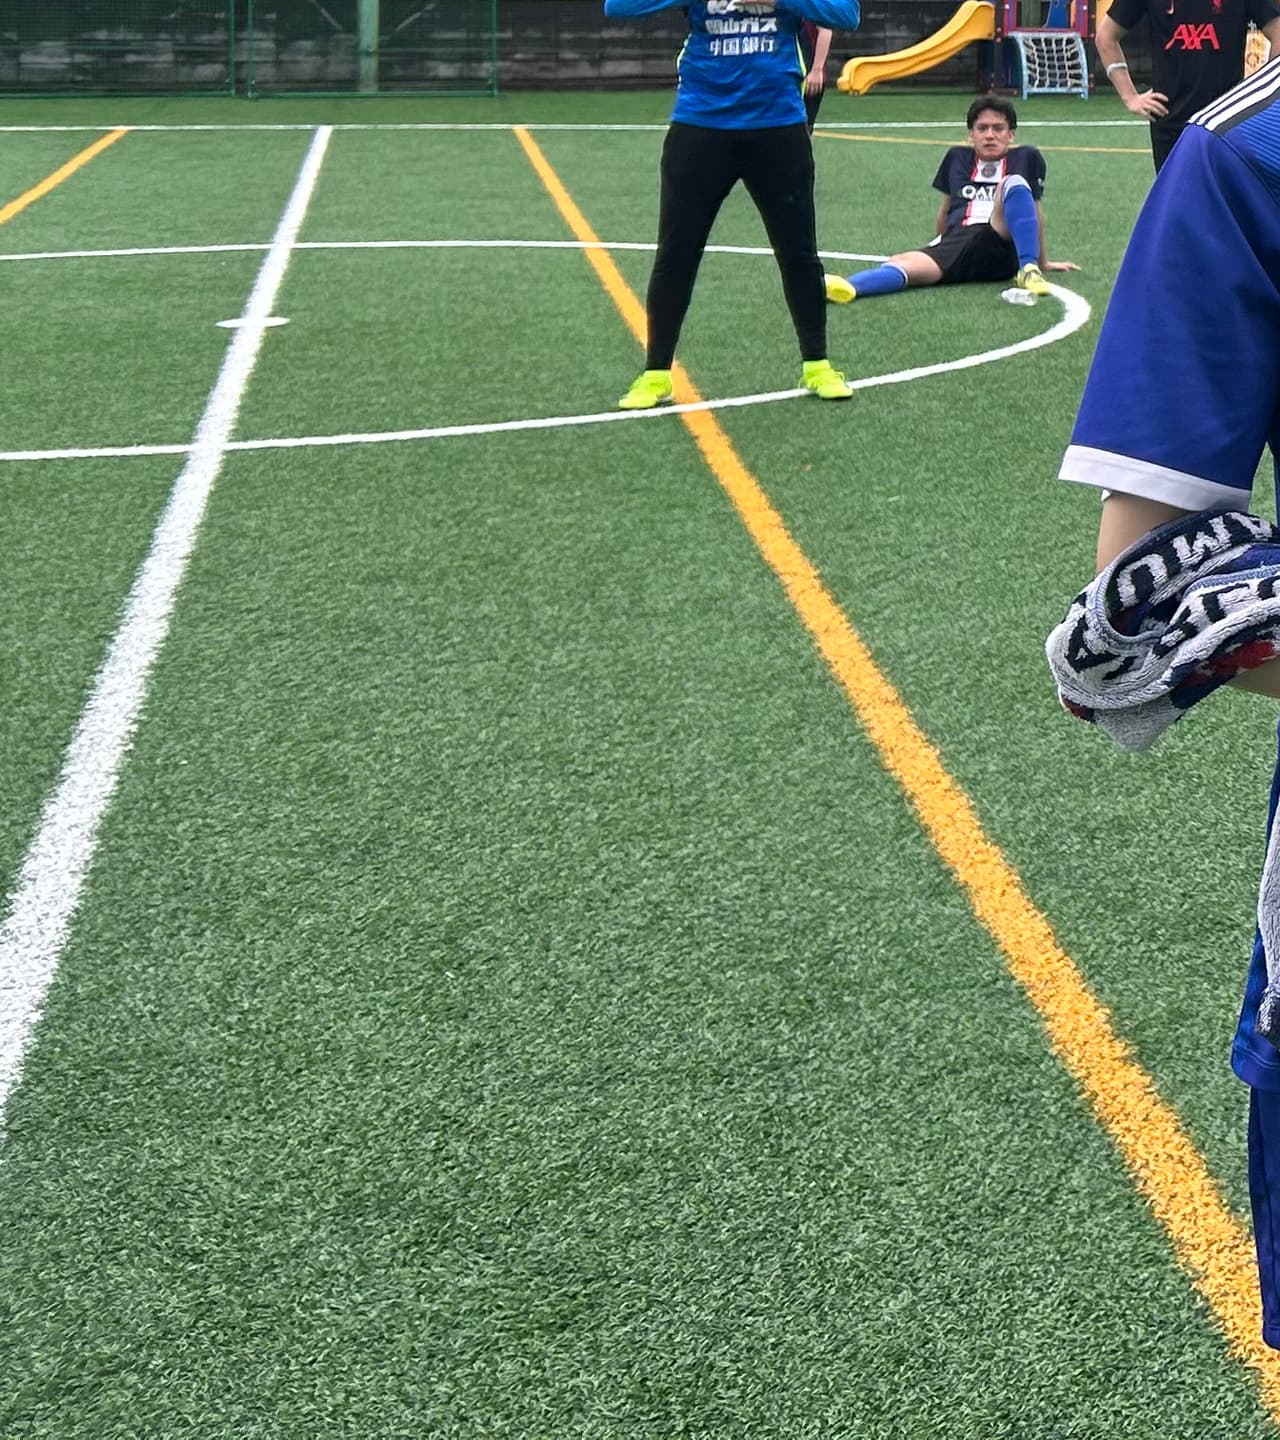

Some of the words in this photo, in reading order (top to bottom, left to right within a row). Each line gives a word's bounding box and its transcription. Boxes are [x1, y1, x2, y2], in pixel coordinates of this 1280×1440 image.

[710, 36, 775, 56] 中国銀行
[1164, 23, 1220, 50] AXA
